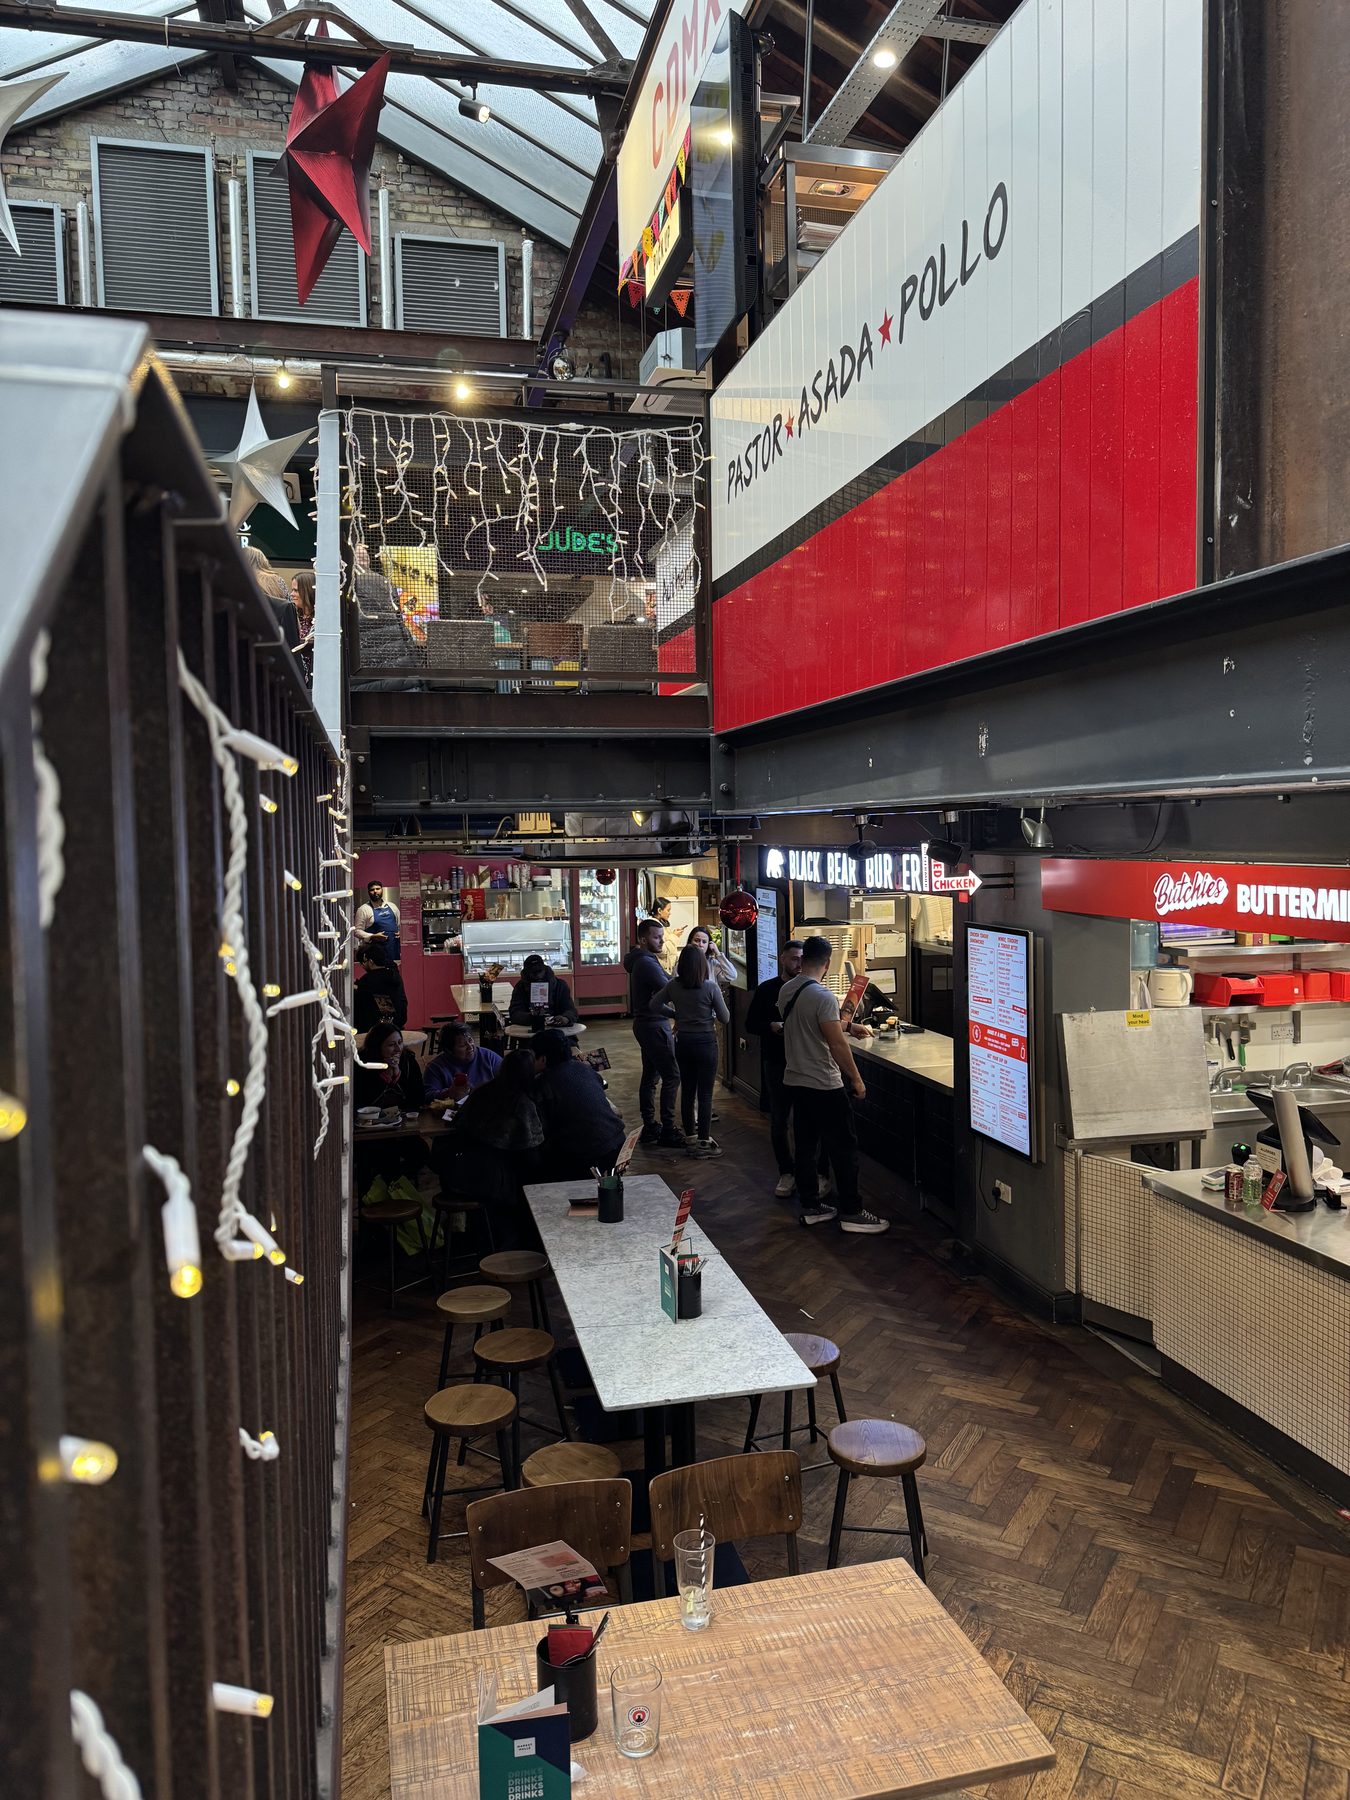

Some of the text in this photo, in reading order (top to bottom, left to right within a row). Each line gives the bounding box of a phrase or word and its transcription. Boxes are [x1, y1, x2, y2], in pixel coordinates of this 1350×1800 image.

[727, 180, 1009, 504] PASTOR ASADA POLLO
[536, 526, 619, 554] JUDE'S
[789, 850, 820, 882] BLACK
[827, 852, 857, 886] BEAR
[866, 853, 922, 891] BURGER
[934, 878, 976, 890] CHICKEN
[1154, 870, 1229, 917] Butchies
[1237, 884, 1350, 922] BUTTERMI
[508, 1767, 543, 1778] DRINKS
[508, 1774, 543, 1786] DRINKS
[508, 1782, 543, 1793] DRINKS
[508, 1789, 544, 1800] DRINKS
